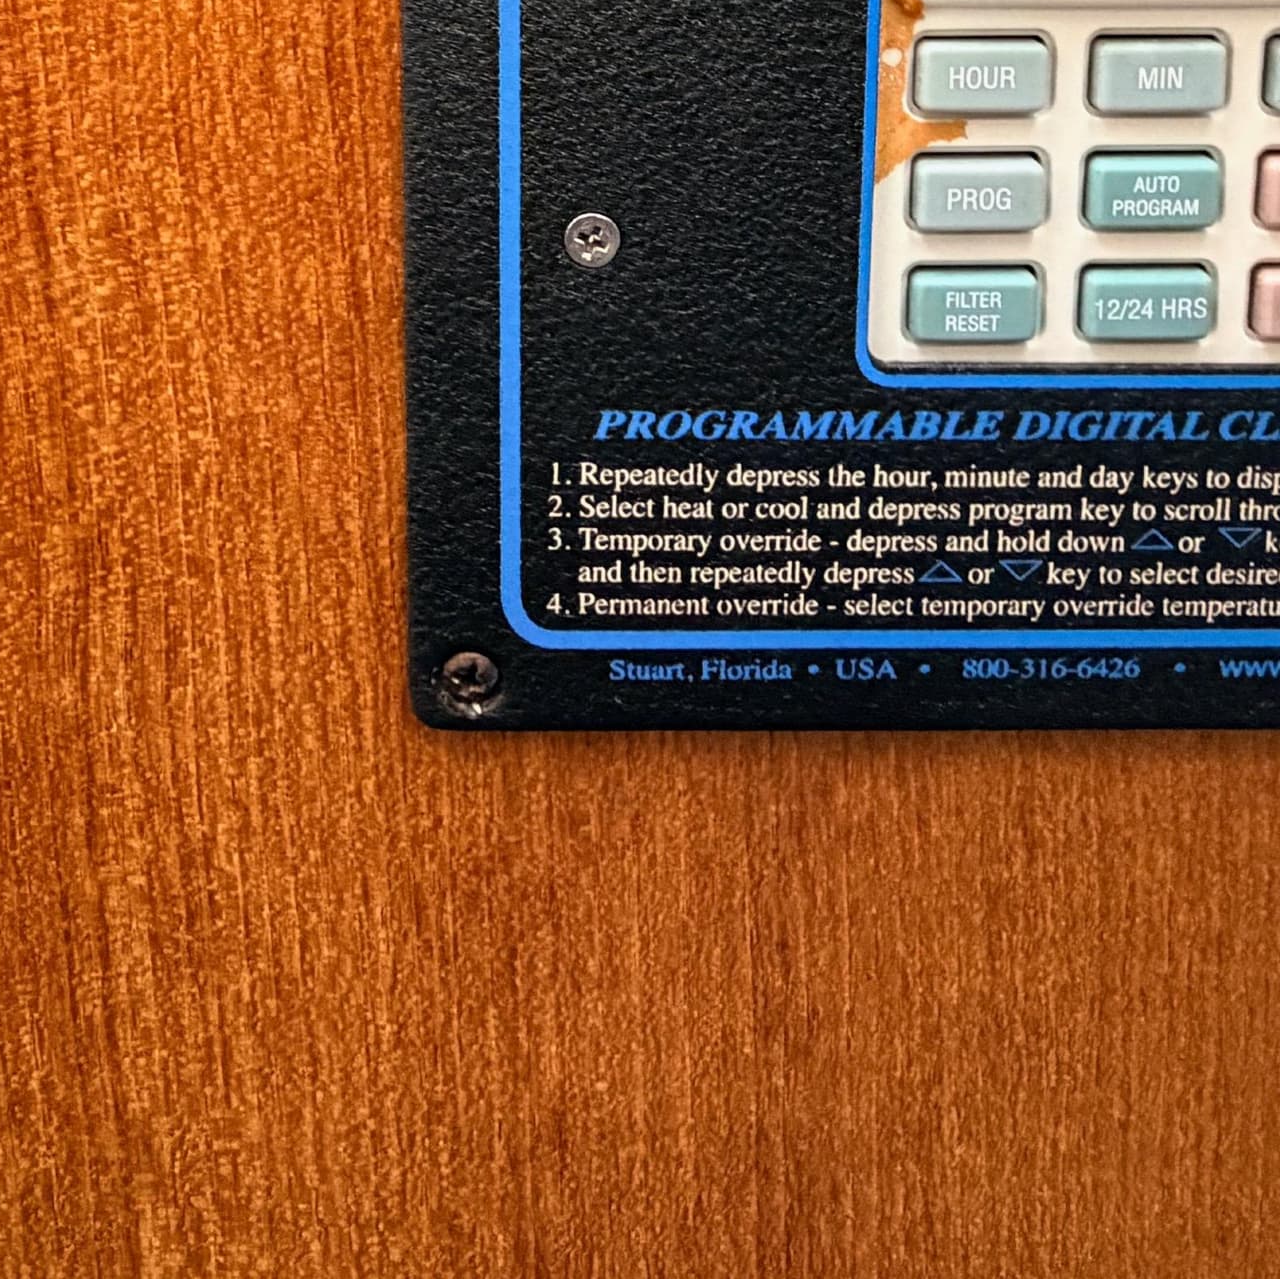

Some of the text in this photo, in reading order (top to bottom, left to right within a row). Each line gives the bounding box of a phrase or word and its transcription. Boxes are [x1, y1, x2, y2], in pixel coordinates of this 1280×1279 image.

[949, 67, 1016, 90] HOUR
[1138, 67, 1183, 90] MIN
[1133, 175, 1180, 194] AUTO
[947, 188, 1011, 211] PROG
[1113, 197, 1199, 217] PROGRAM
[945, 291, 1002, 310] FILTER
[1095, 297, 1207, 321] 12/24 HRS
[945, 314, 1000, 333] RESET
[593, 410, 1003, 441] PROGRAMMABLE
[1013, 410, 1209, 441] DIGITAL
[551, 462, 571, 486] 1.
[579, 462, 719, 493] Repeatedly
[726, 463, 820, 493] depress
[828, 463, 865, 487] the
[873, 464, 938, 492] hour,
[944, 464, 1030, 488] minute
[1037, 464, 1082, 488] and
[1089, 465, 1134, 494] day
[1142, 465, 1198, 494] keys
[1206, 469, 1230, 489] to
[548, 495, 571, 518] 2.
[579, 495, 654, 518] Select
[663, 496, 714, 519] heat
[722, 502, 749, 519] or
[755, 496, 808, 519] cool
[816, 496, 860, 520] and
[868, 496, 960, 526] depress
[968, 502, 1071, 526] program
[1081, 498, 1125, 527] key
[1132, 501, 1155, 521] to
[1163, 498, 1230, 521] scroll
[548, 527, 570, 550] 3.
[578, 527, 712, 557] Temporary
[720, 529, 821, 551] override
[846, 529, 938, 558] depress
[945, 529, 989, 552] and
[997, 529, 1050, 552] hold
[1057, 530, 1124, 552] down
[1178, 536, 1205, 553] or
[578, 560, 622, 583] and
[630, 560, 682, 583] then
[690, 561, 816, 590] repeatedly
[823, 561, 915, 590] depress
[968, 567, 995, 584] or
[1047, 562, 1091, 591] key
[1099, 565, 1122, 584] to
[1129, 562, 1199, 585] select
[546, 592, 570, 615] 4.
[578, 592, 709, 616] Permanent
[717, 593, 818, 616] override
[844, 593, 913, 616] select
[921, 596, 1045, 622] temporary
[1053, 593, 1154, 616] override
[609, 659, 694, 682] Stuart,
[701, 658, 792, 680] Florida
[836, 658, 897, 680] USA
[962, 657, 1140, 680] 800-316-6426
